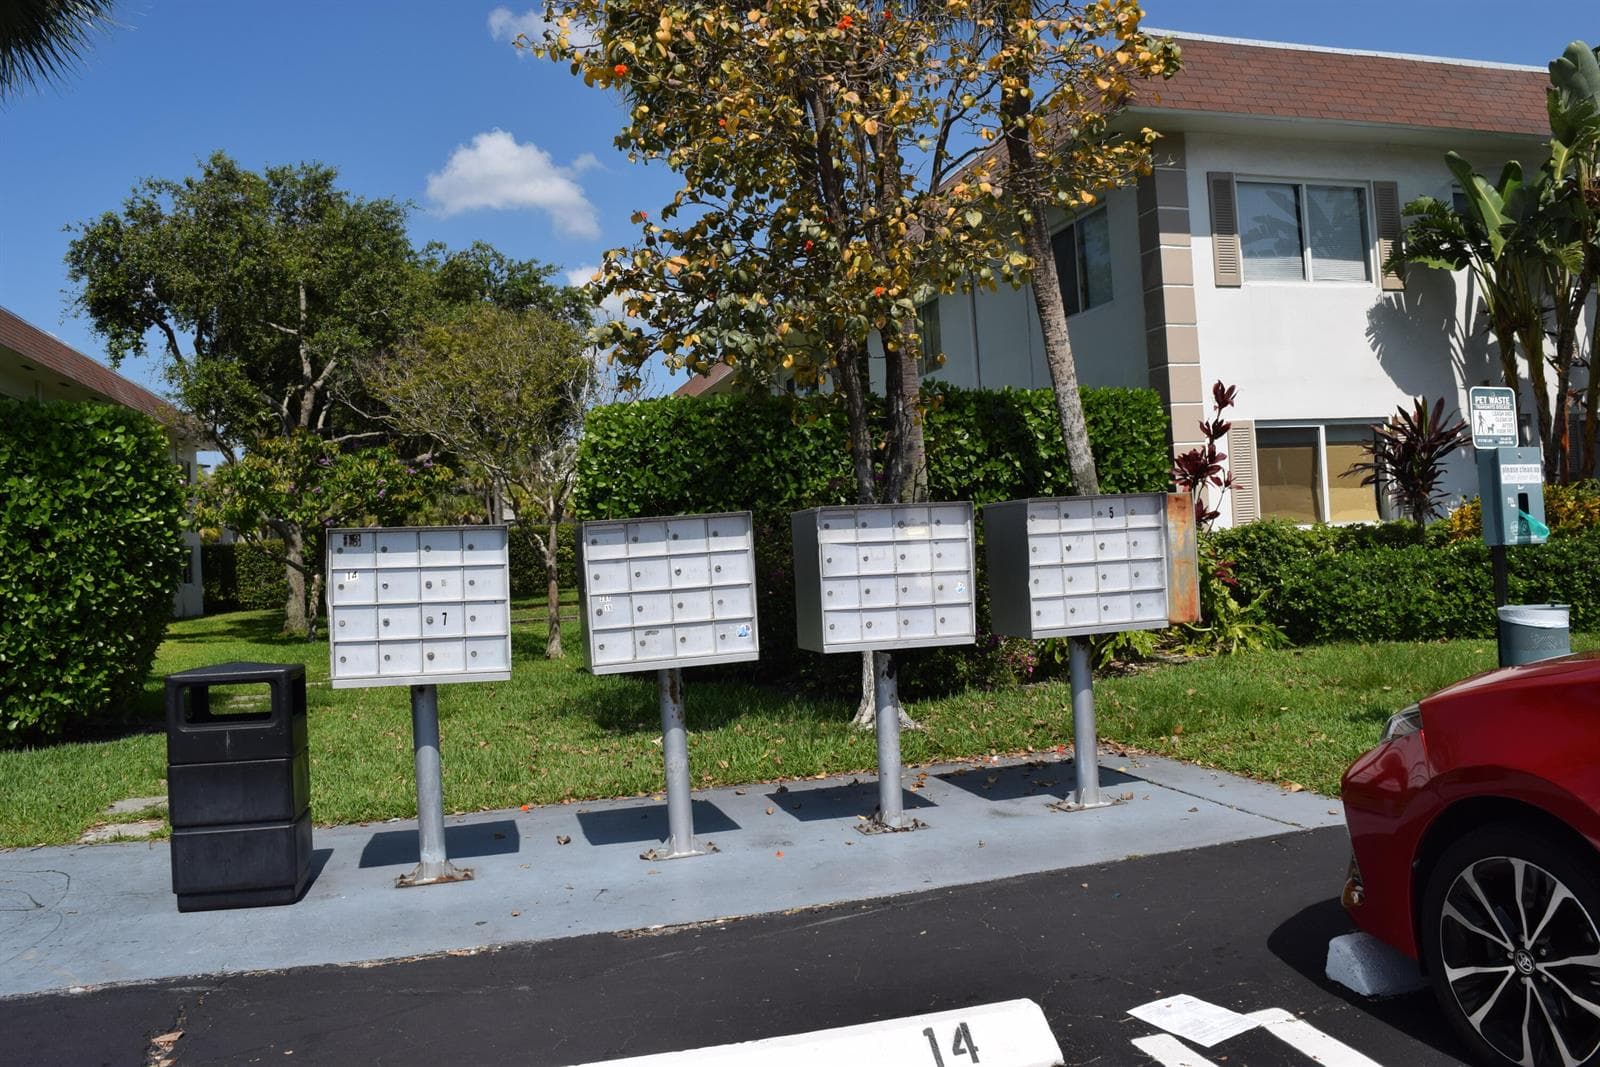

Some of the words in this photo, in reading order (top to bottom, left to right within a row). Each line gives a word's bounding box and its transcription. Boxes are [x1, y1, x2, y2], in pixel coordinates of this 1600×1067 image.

[1474, 396, 1487, 404] PET
[1488, 396, 1510, 404] WASTE
[1109, 506, 1114, 519] 5
[442, 612, 447, 626] 7
[923, 1022, 979, 1067] 14
